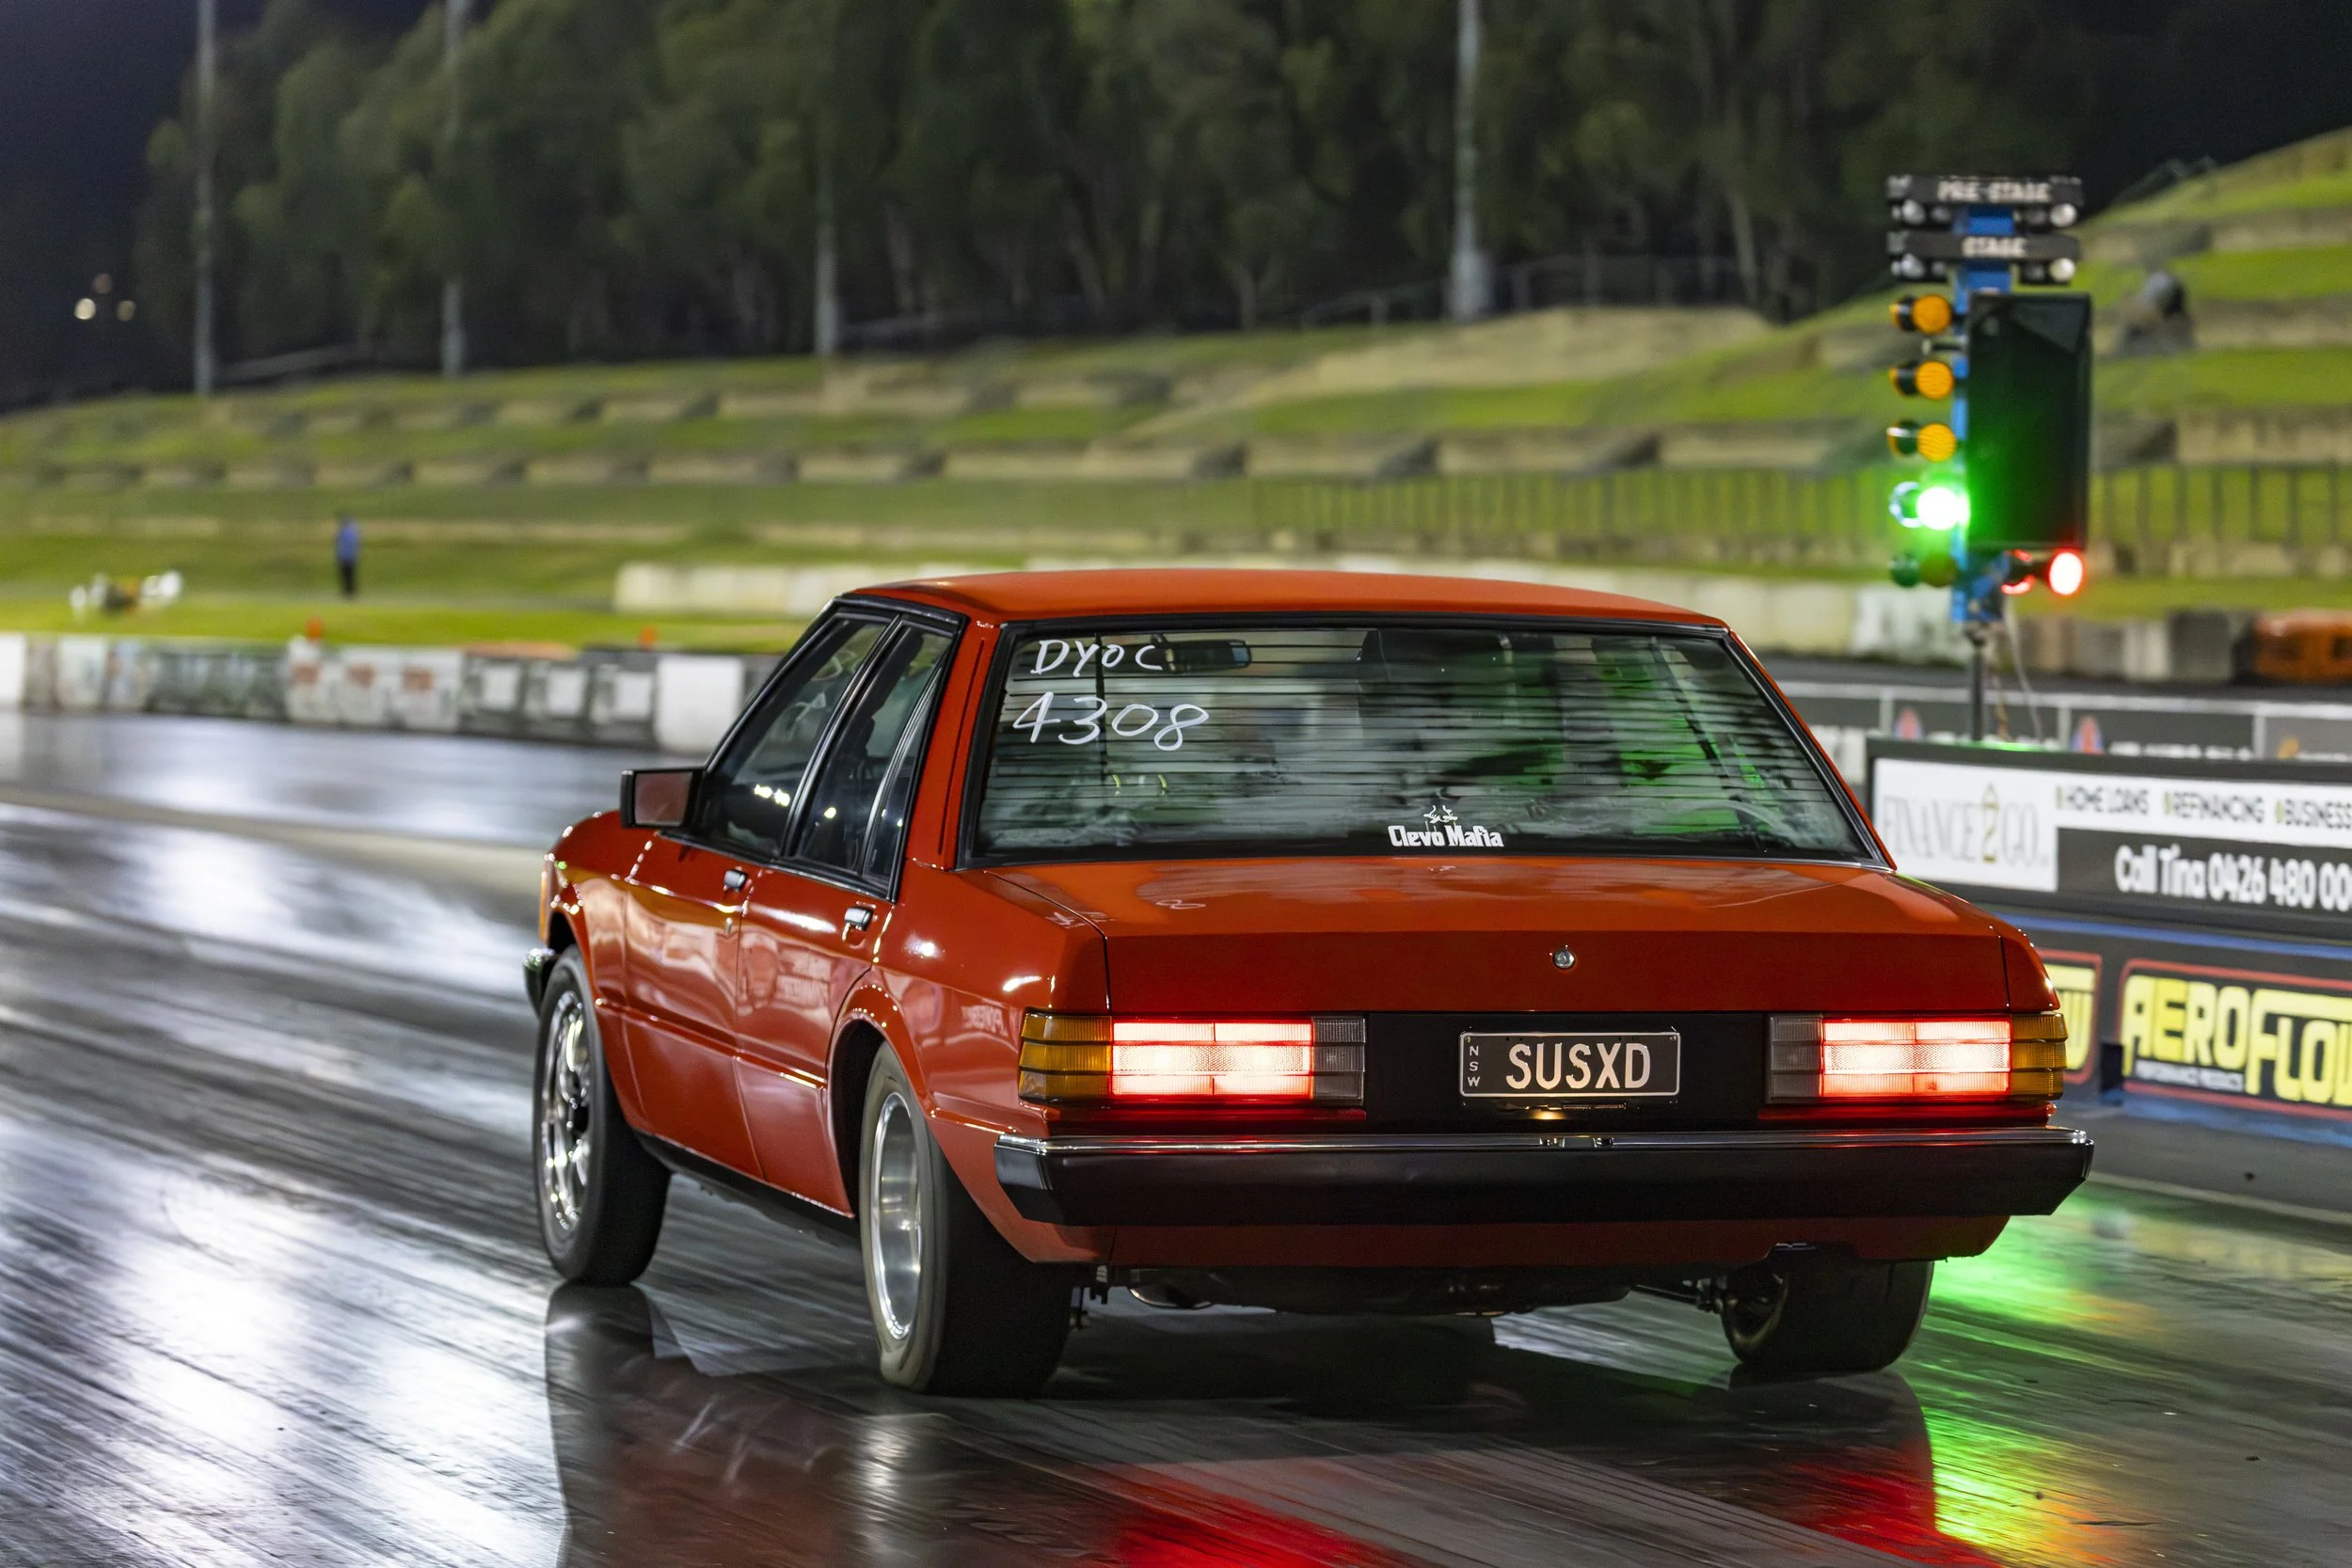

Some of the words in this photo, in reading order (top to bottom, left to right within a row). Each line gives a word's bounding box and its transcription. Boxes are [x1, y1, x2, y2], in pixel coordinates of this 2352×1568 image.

[1962, 236, 2026, 258] STAGE
[1012, 691, 1209, 751] 4308
[2065, 785, 2104, 813] HOME
[2107, 787, 2150, 816] LOANS
[2171, 791, 2265, 824] REFINANCING
[1388, 825, 1445, 847] Clevo
[1444, 824, 1504, 847] Mafia
[2115, 845, 2157, 893] Call
[2159, 844, 2206, 899] Tina
[2208, 852, 2266, 905] 0426
[2269, 857, 2316, 910] 480
[1506, 1042, 1651, 1090] SUSXD
